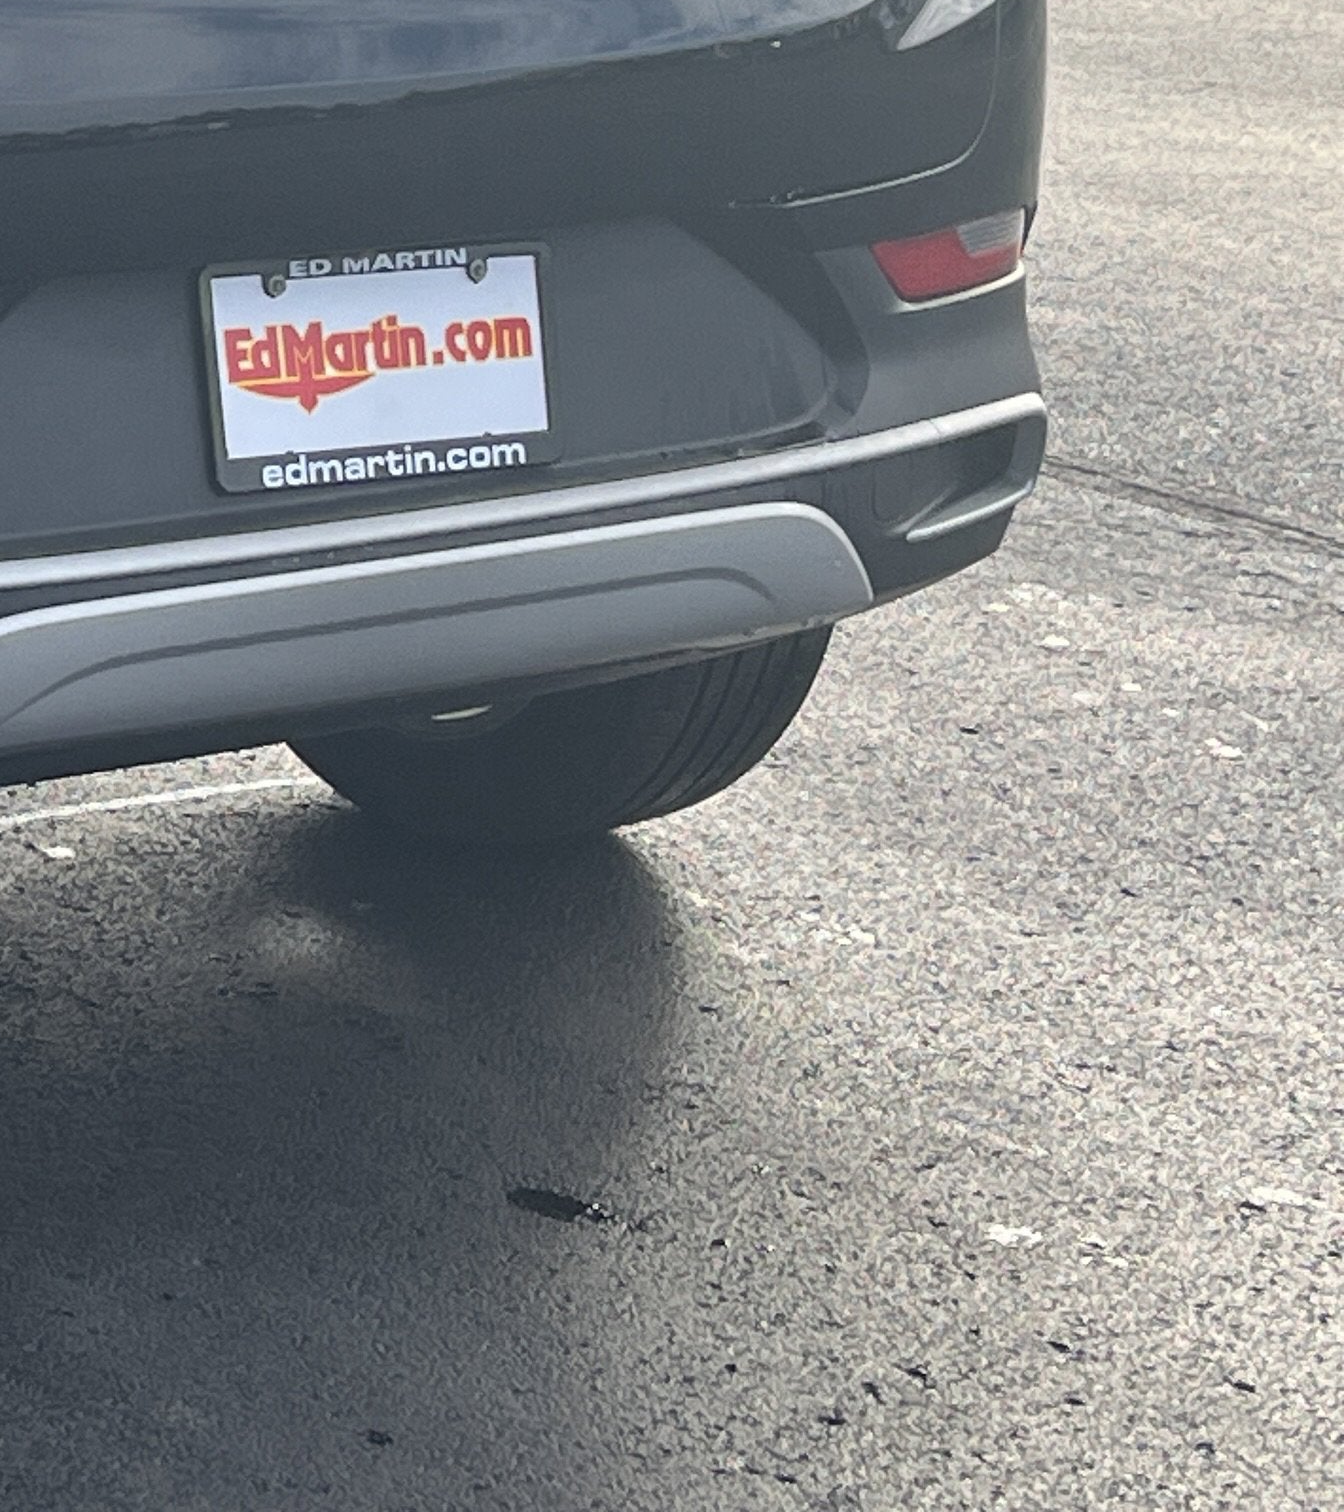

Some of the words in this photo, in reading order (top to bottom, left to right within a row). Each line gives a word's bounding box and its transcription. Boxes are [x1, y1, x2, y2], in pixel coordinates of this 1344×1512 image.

[288, 257, 332, 278] ED
[342, 248, 467, 274] MARTIN
[262, 441, 526, 488] edmartin.com
